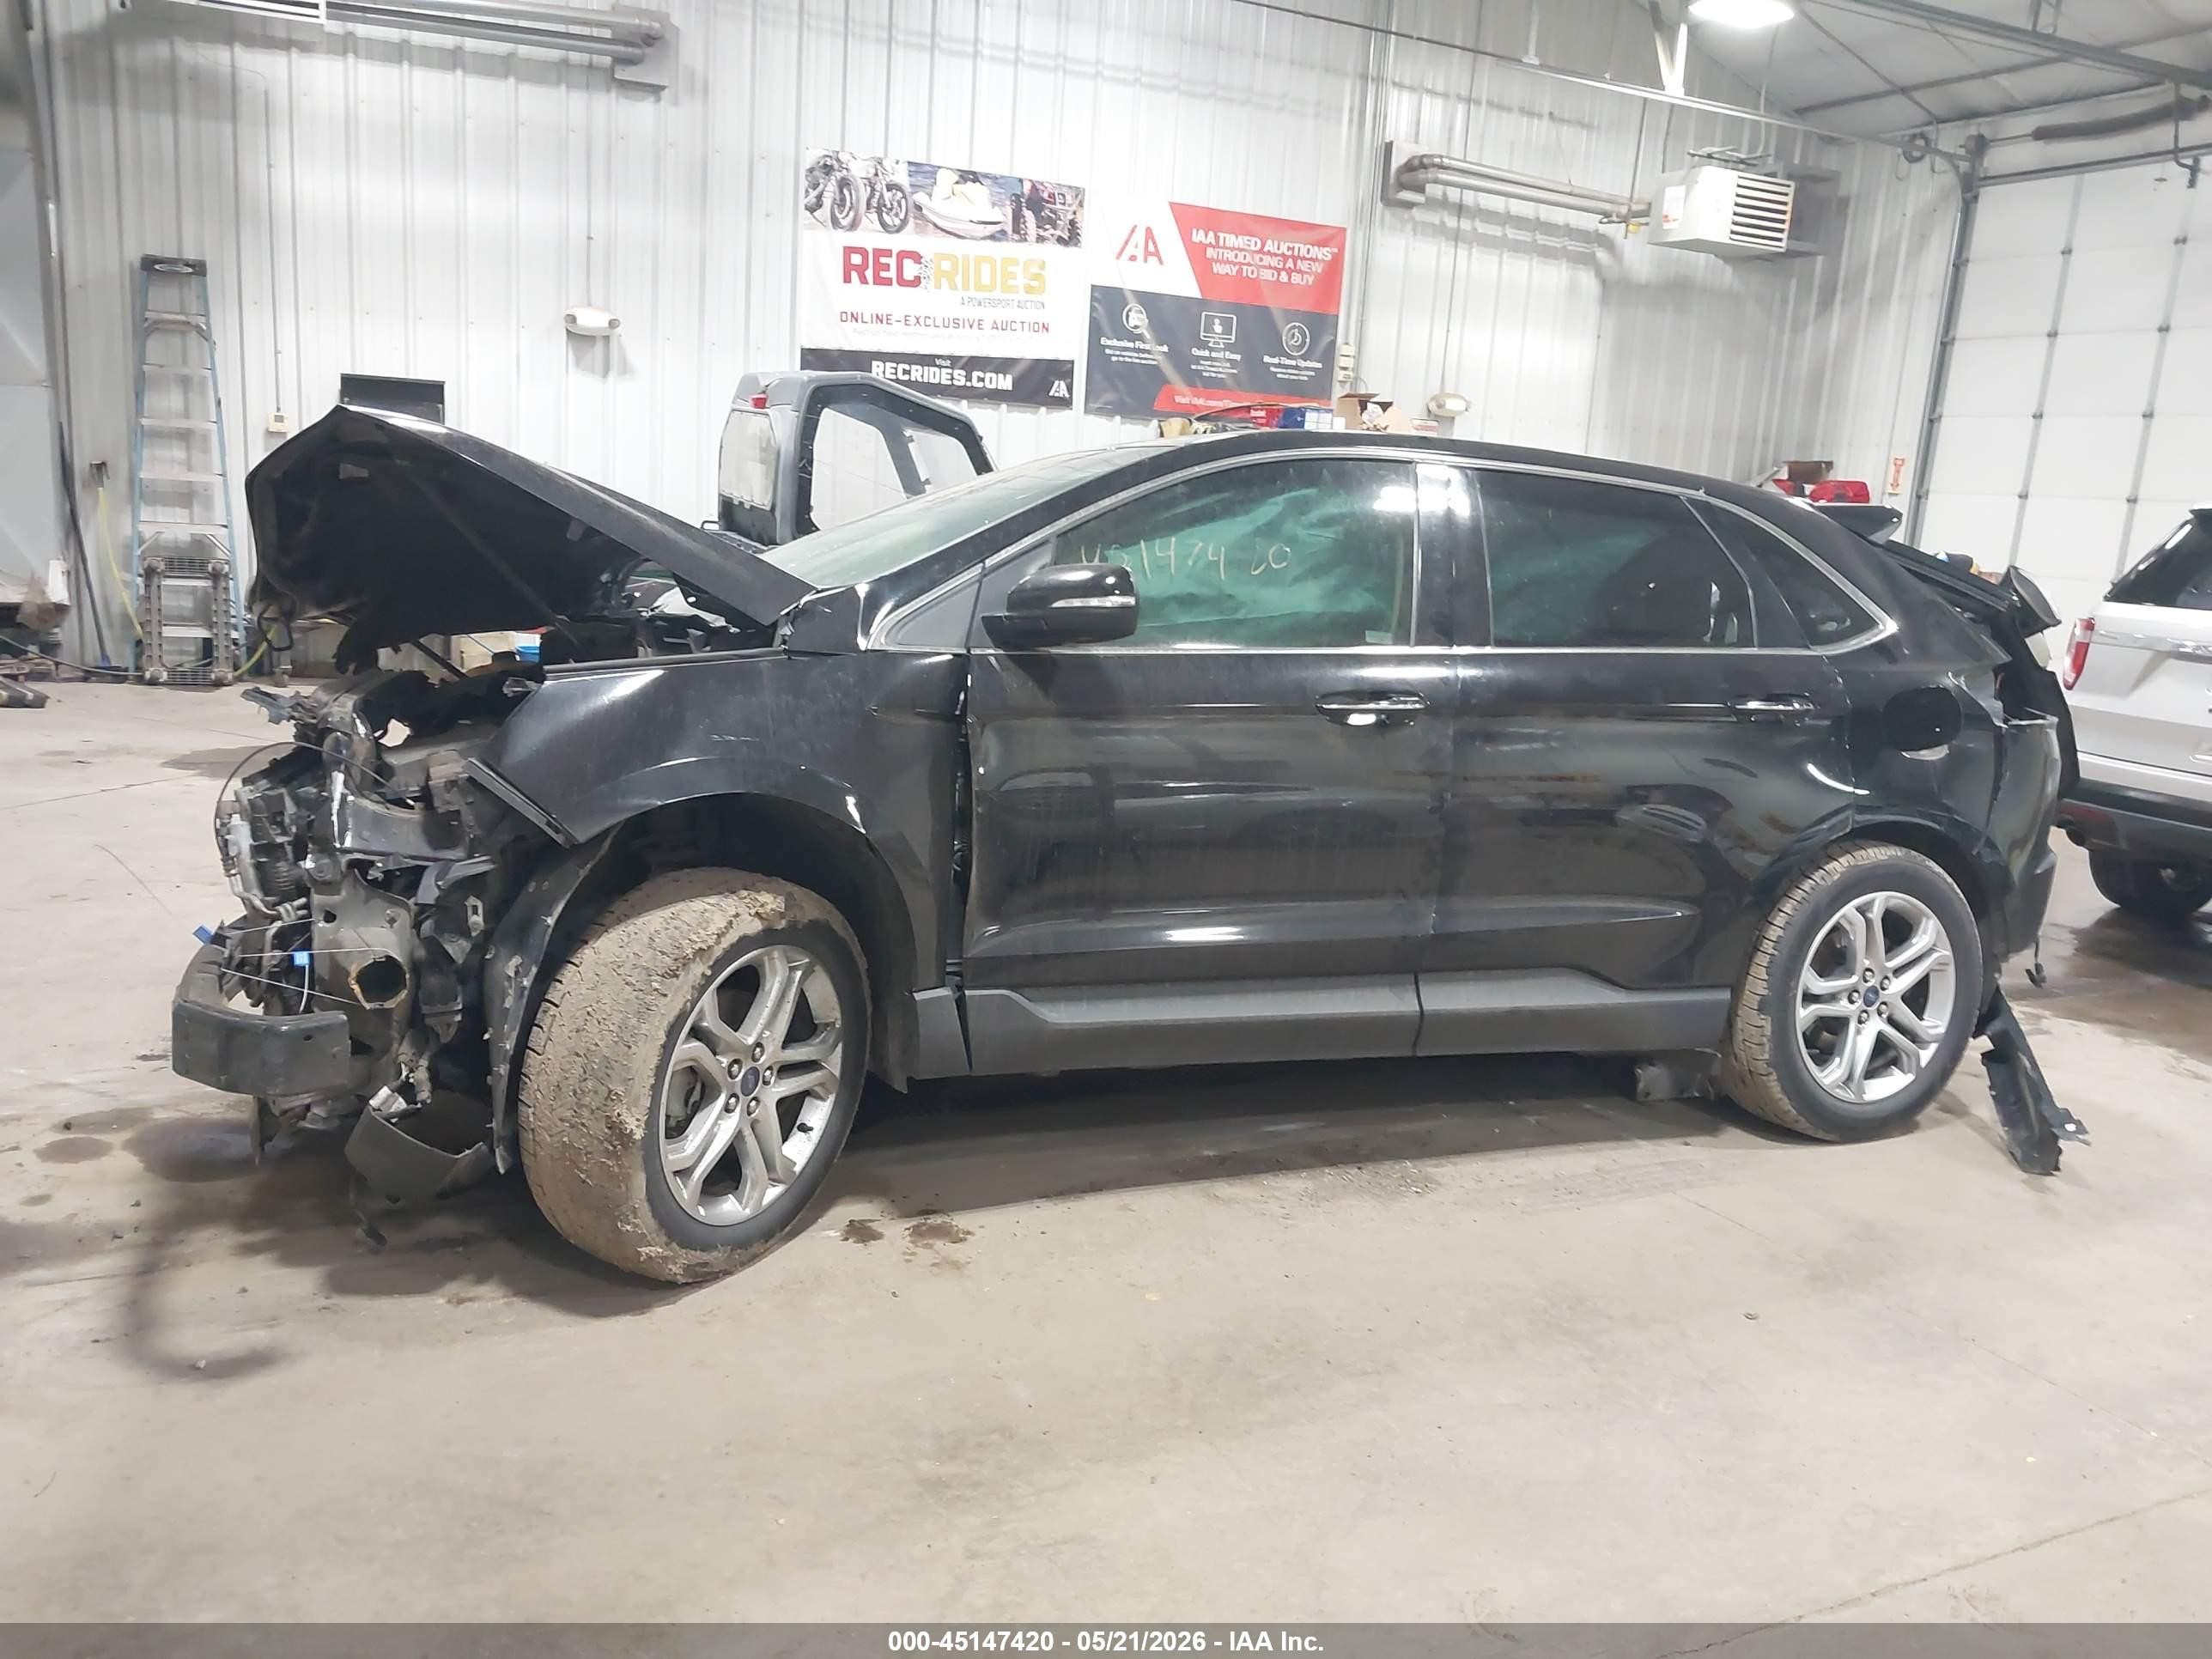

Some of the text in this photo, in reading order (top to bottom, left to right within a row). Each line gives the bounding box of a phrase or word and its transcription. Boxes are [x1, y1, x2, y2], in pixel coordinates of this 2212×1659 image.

[1191, 228, 1216, 245] IAA
[1217, 233, 1261, 252] TIMED
[842, 246, 1047, 295] REC RIDES
[1205, 247, 1324, 274] INTRODUCING A NEW
[1212, 262, 1241, 276] WAY
[1242, 265, 1258, 278] TO
[1279, 270, 1289, 283] &
[1290, 272, 1316, 286] BUY
[967, 296, 1015, 309] POWERSPORT
[1016, 299, 1045, 310] AUCTION
[840, 311, 1050, 334] ONLINE-EXCLUSIVE AUCTION
[934, 357, 952, 368] Visit
[871, 360, 1013, 391] RECRIDES.COM
